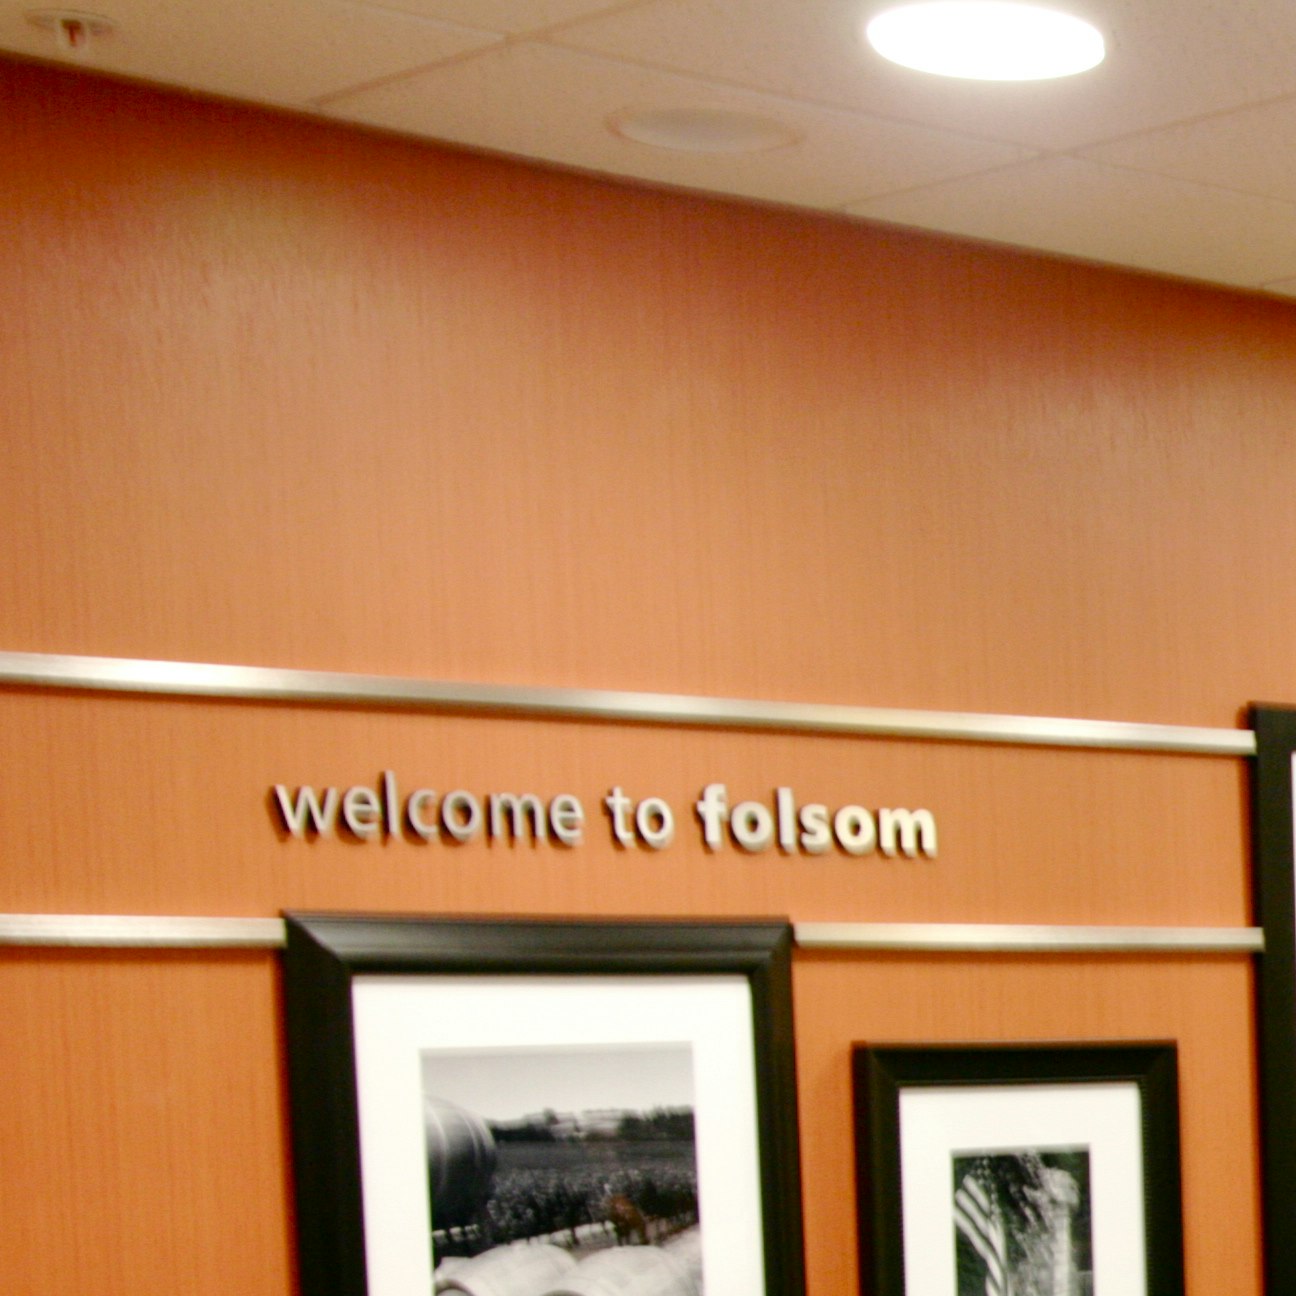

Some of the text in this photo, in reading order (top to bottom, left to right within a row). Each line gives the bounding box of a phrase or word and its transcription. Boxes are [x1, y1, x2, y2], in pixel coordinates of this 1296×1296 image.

[273, 770, 938, 857] welcome to folsom
